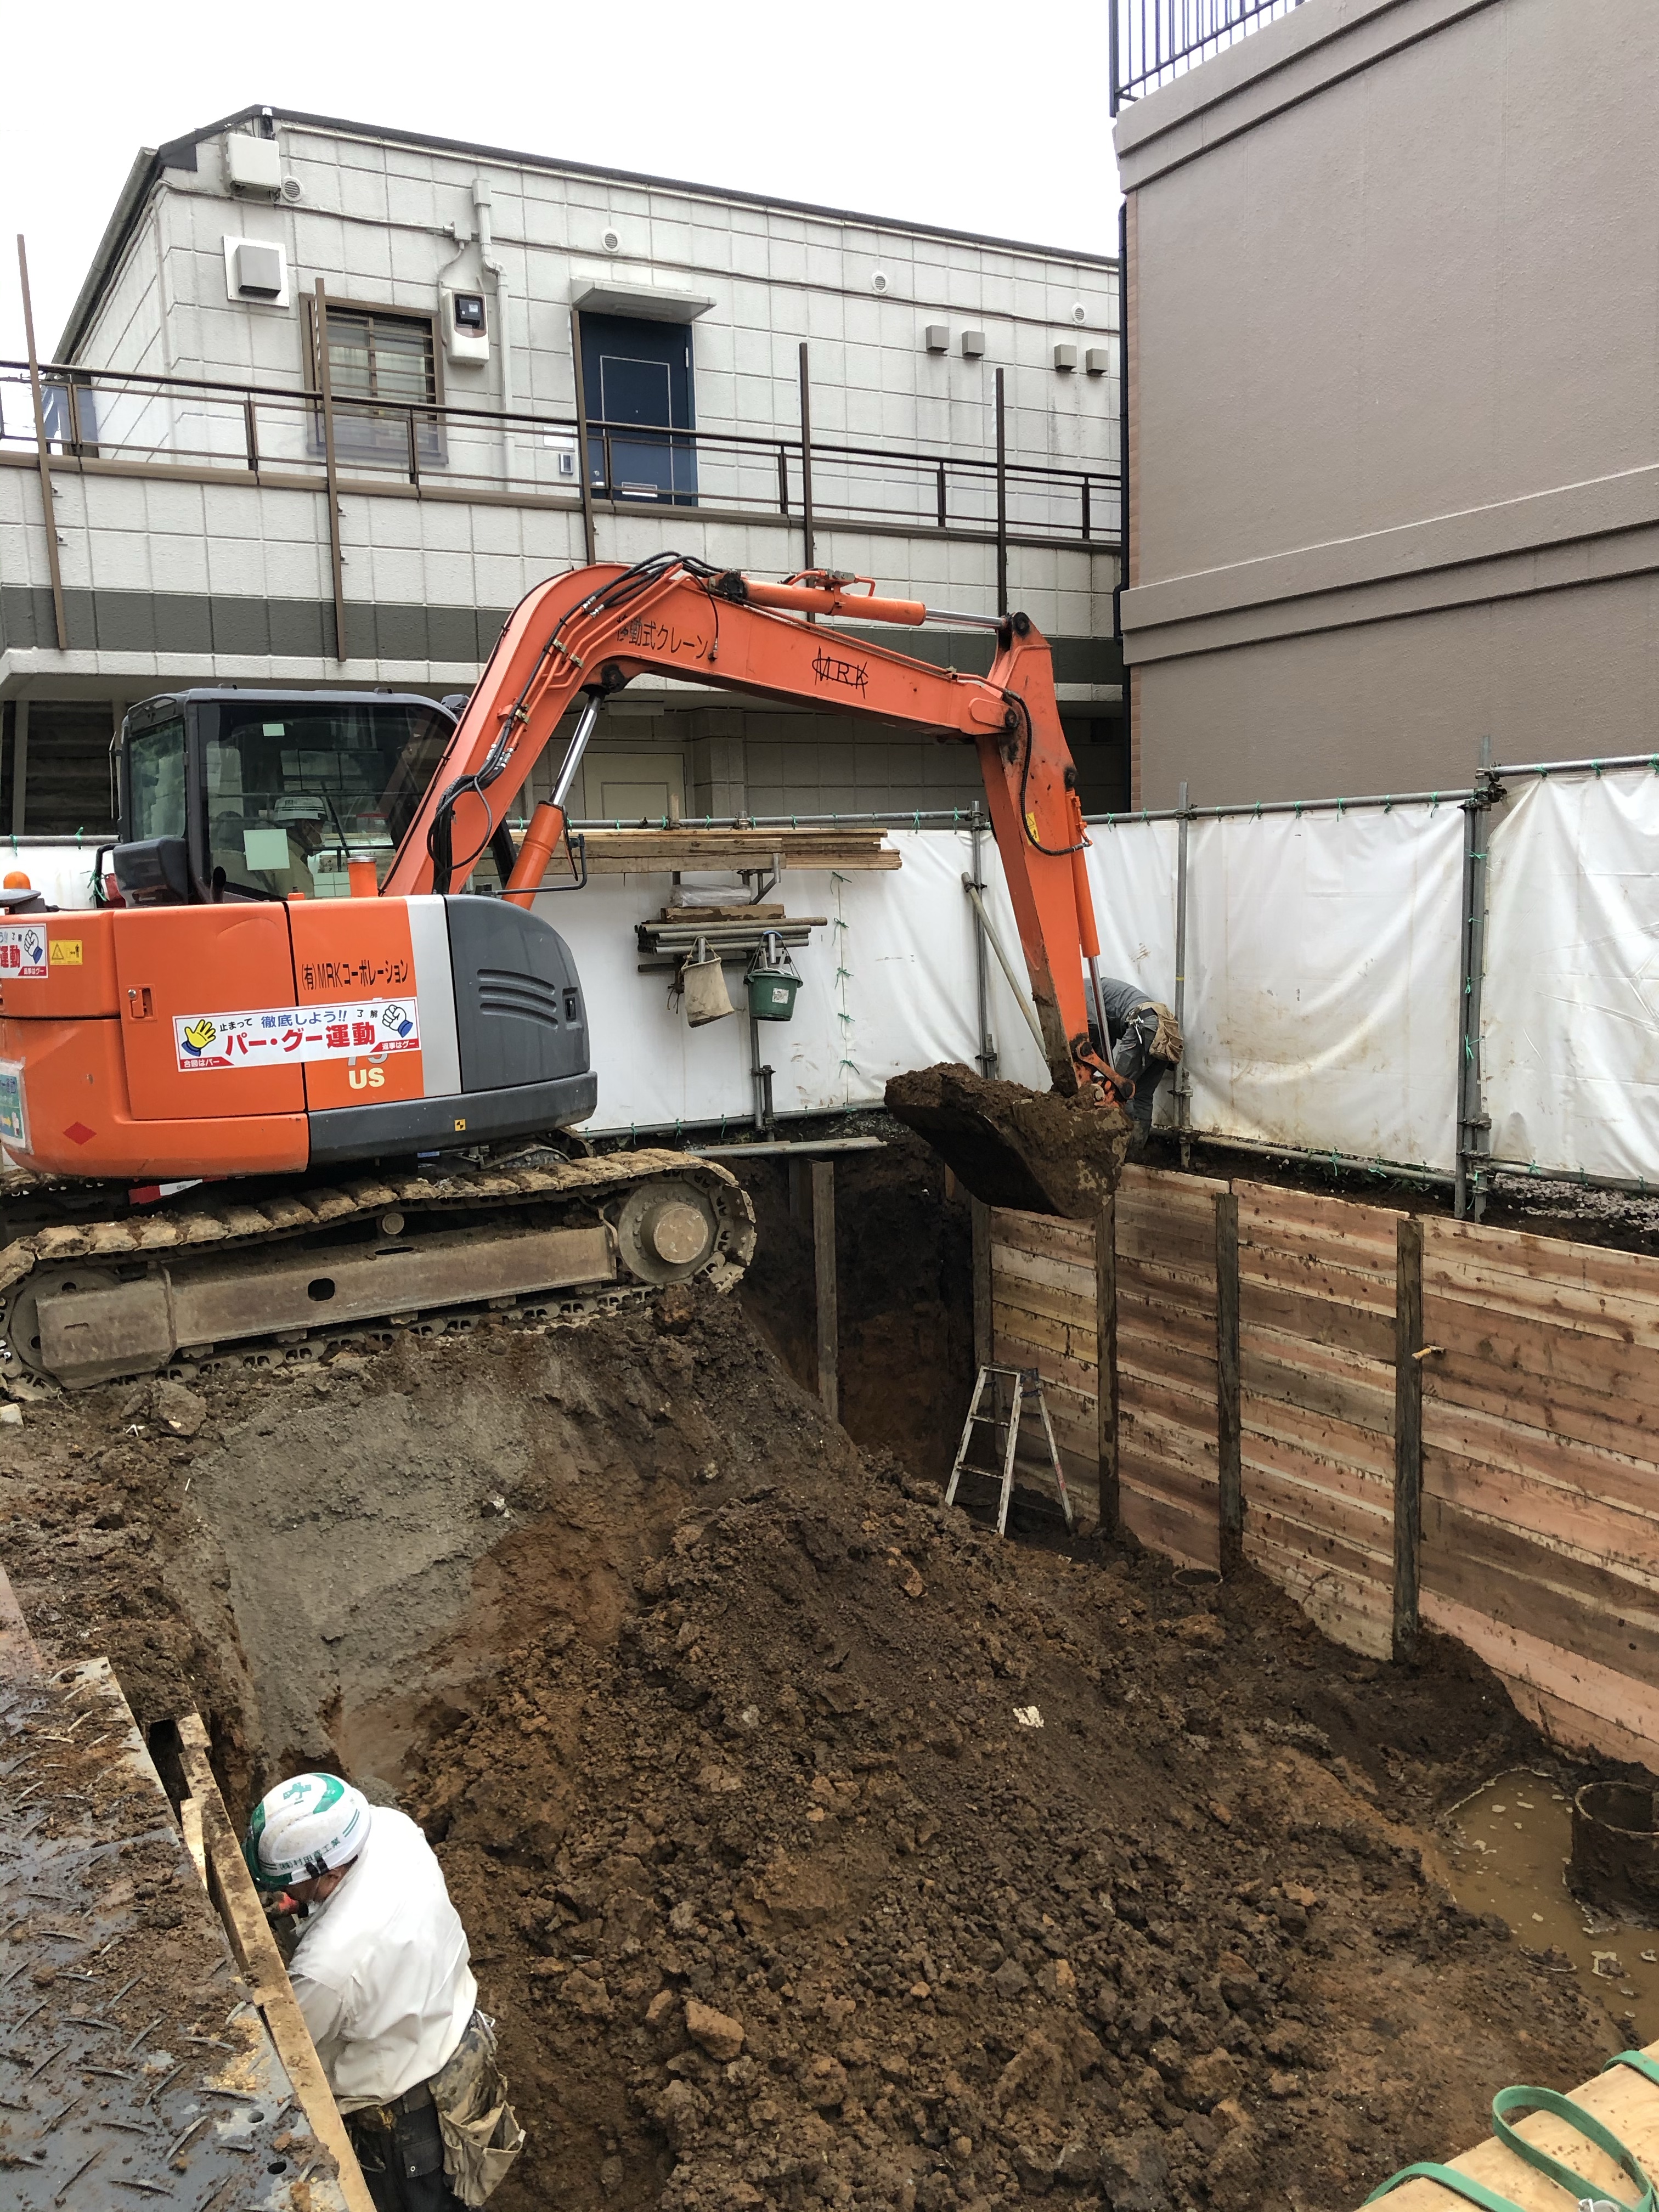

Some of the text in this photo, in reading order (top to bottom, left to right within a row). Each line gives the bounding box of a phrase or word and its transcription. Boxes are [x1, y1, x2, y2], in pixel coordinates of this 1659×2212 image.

[219, 1018, 253, 1032] 止まって
[382, 1040, 415, 1050] 返事はグー
[348, 1067, 385, 1090] US
